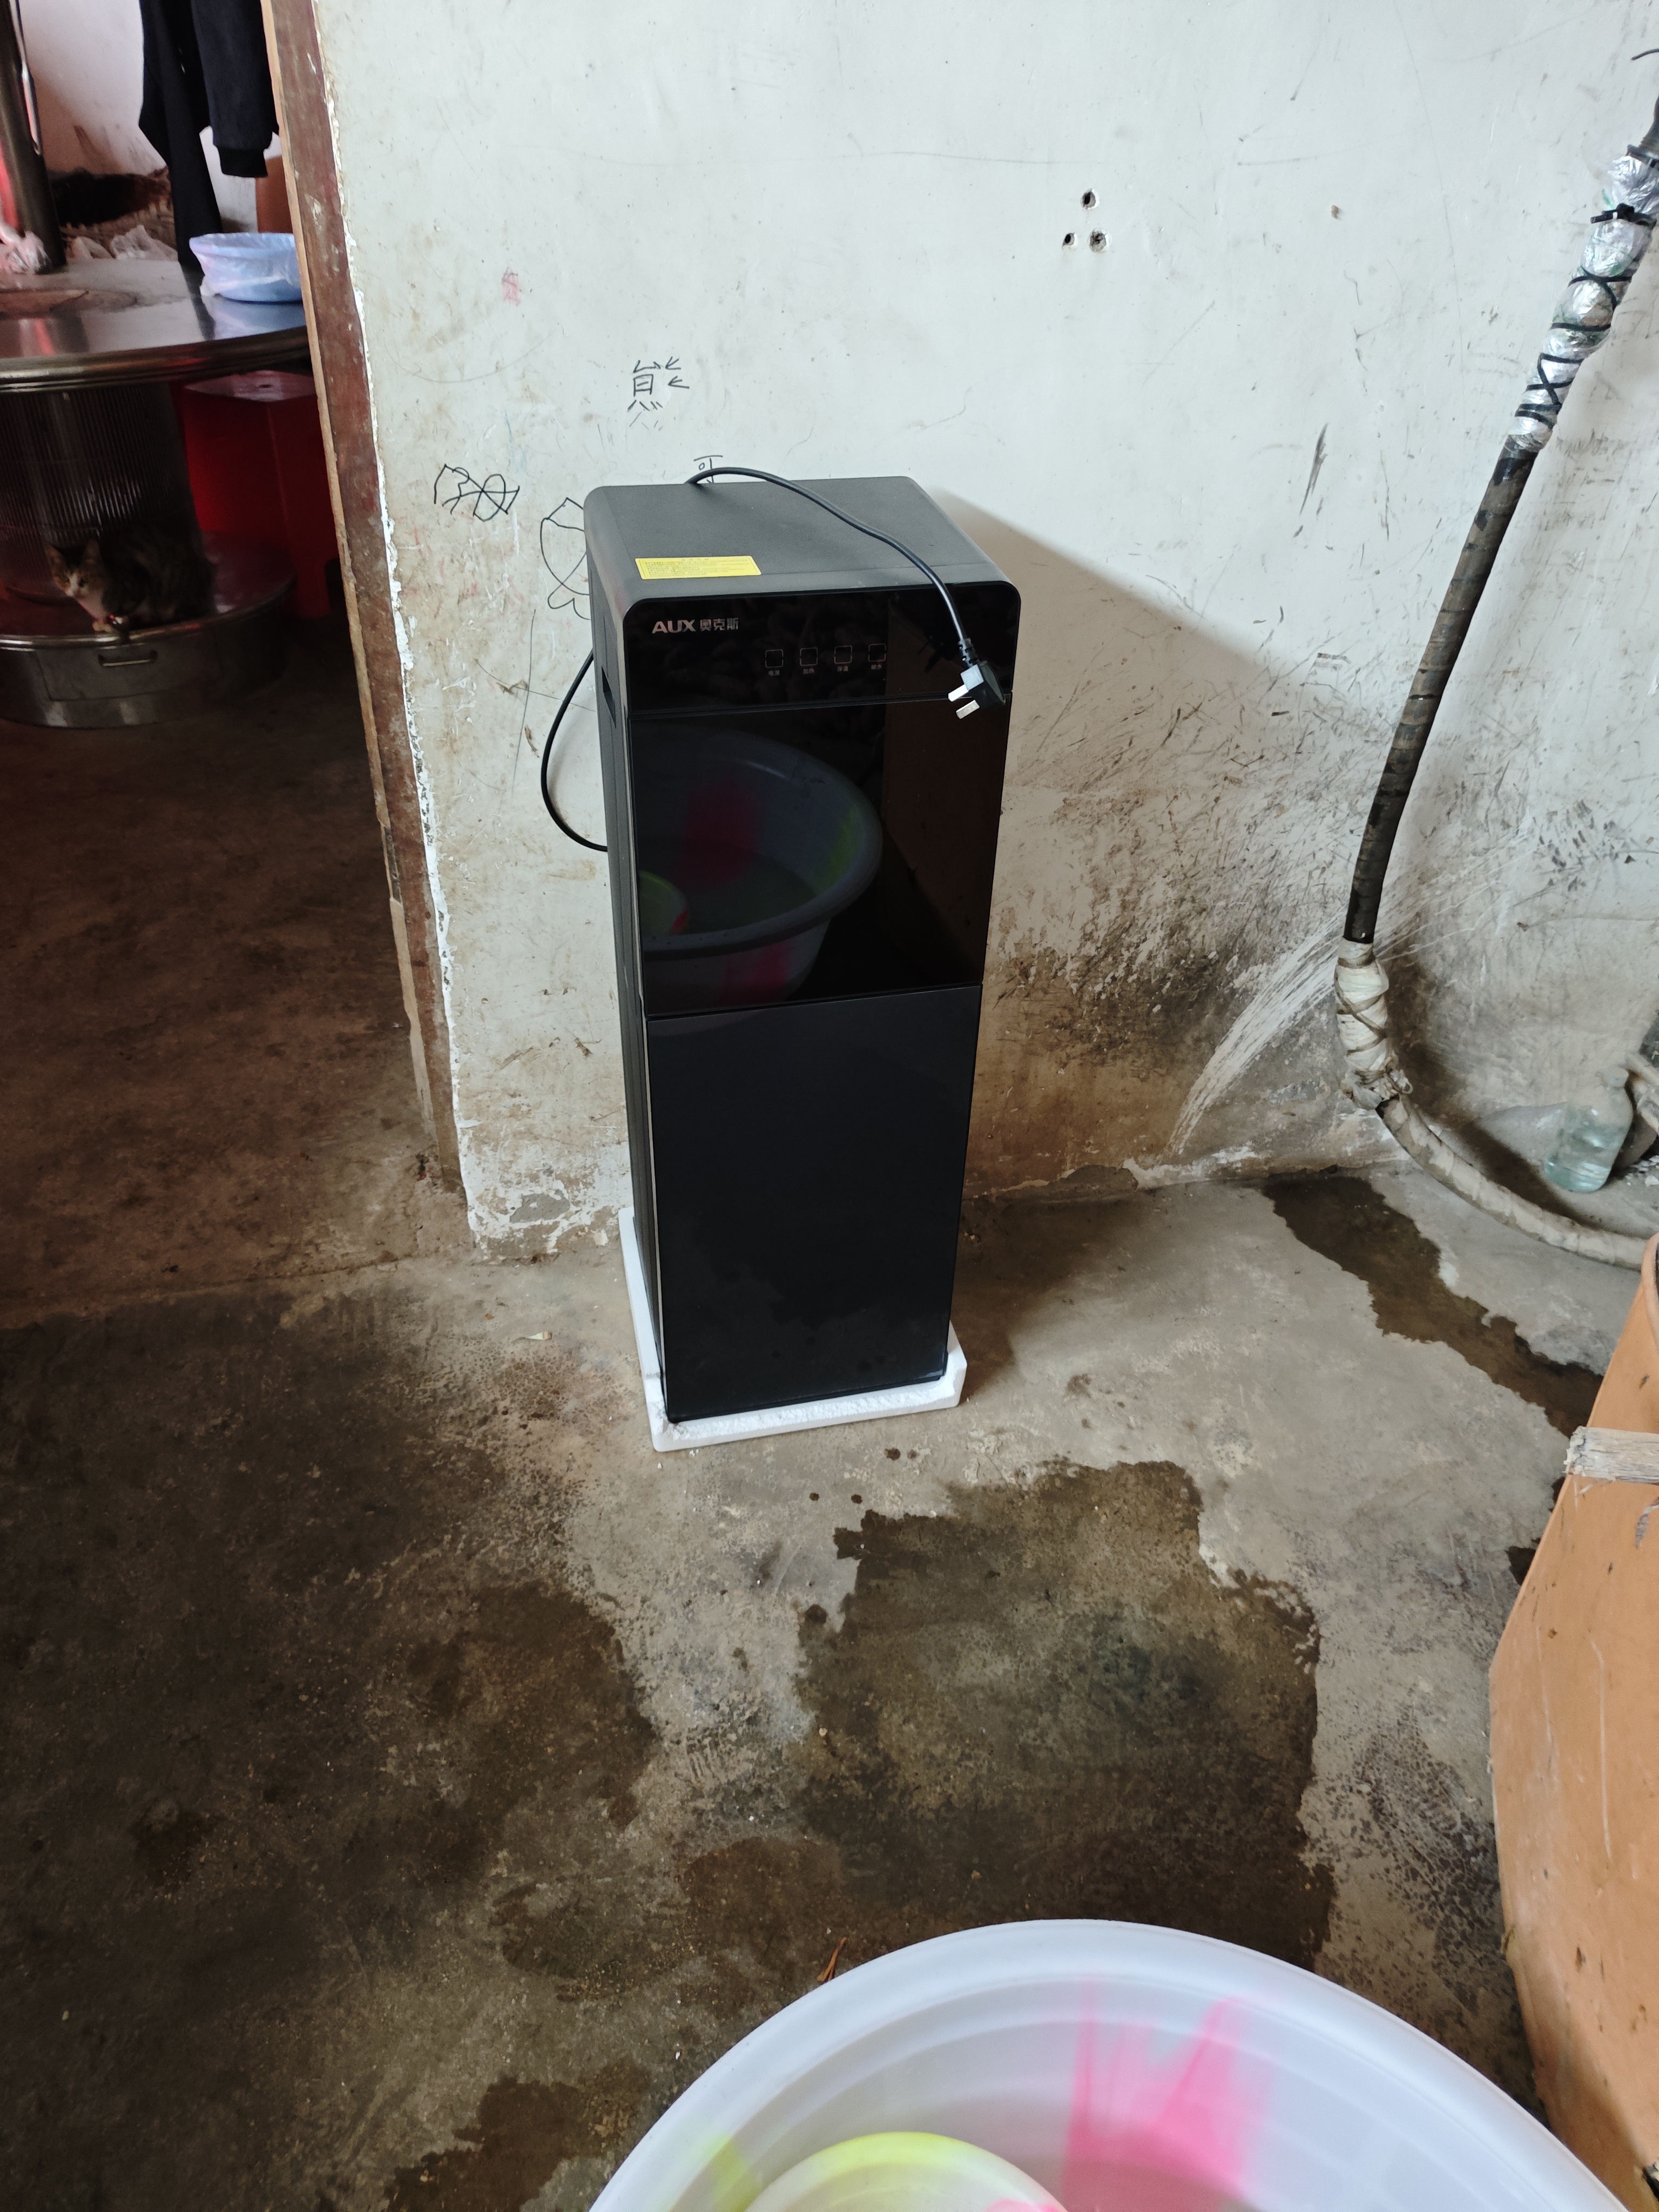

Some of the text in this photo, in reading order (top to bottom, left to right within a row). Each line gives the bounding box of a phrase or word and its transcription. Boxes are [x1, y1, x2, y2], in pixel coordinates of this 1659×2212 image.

[651, 617, 739, 634] AUX 奥克斯
